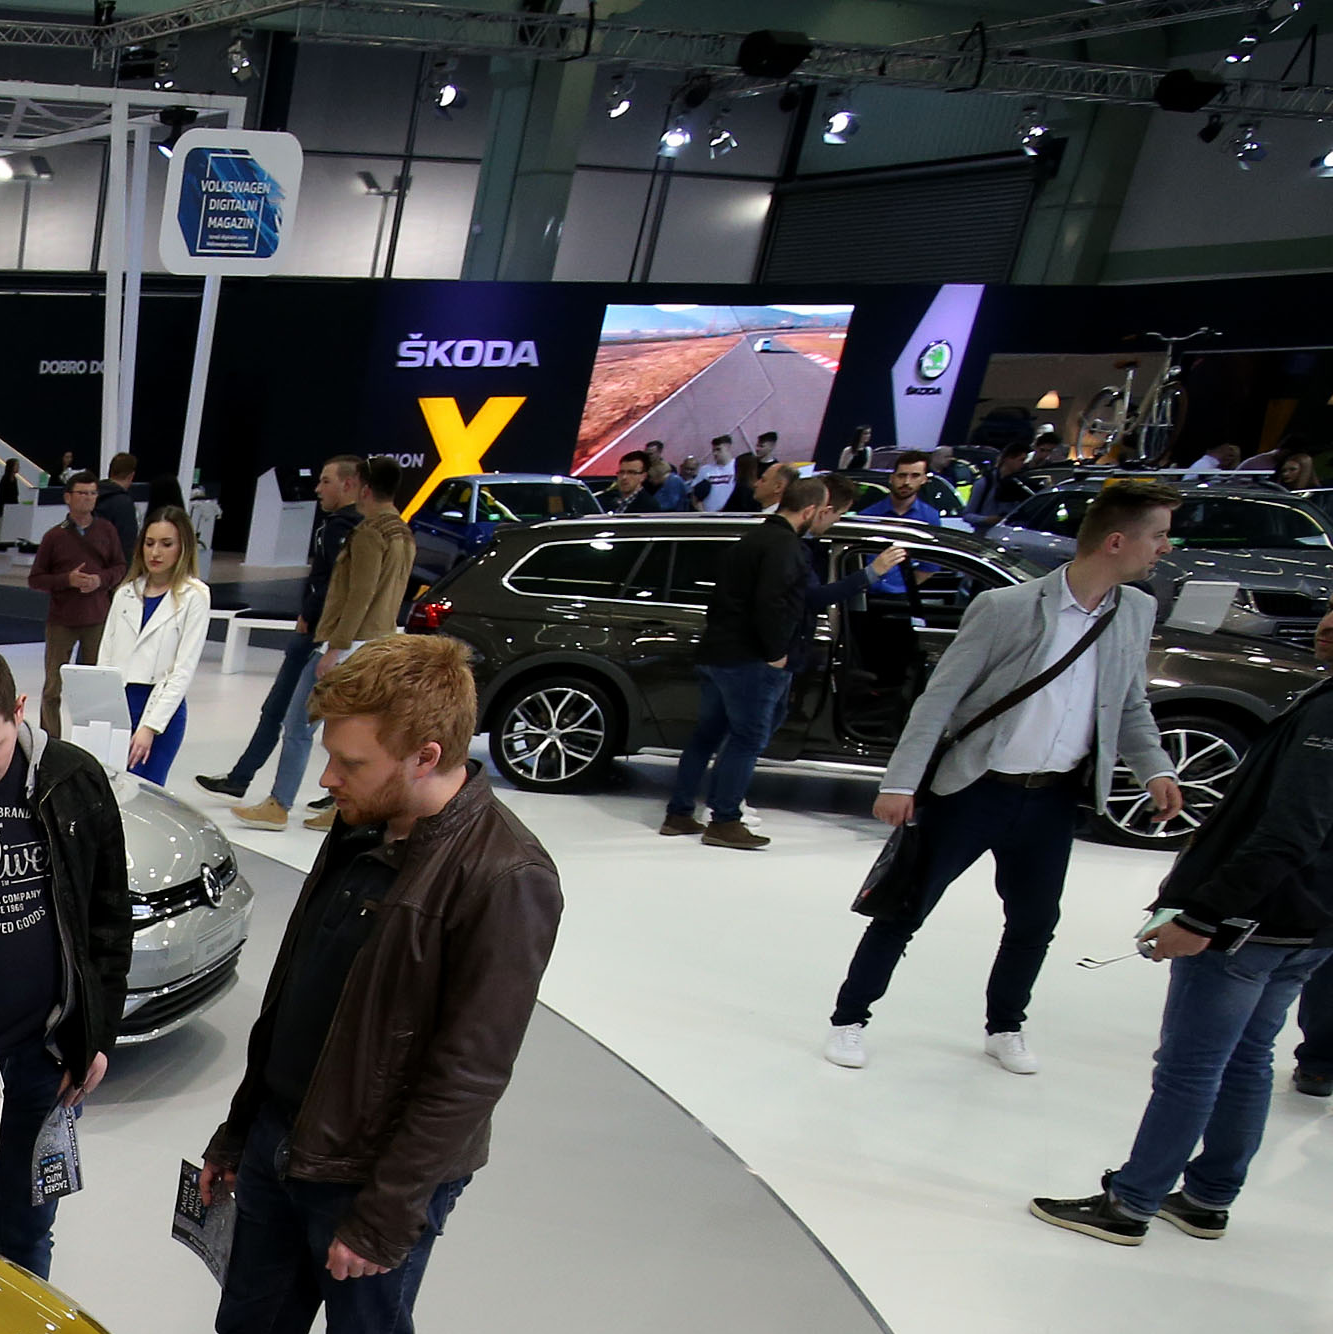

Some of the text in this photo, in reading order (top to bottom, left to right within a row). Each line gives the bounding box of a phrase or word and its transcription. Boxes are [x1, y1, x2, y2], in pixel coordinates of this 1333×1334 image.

[201, 180, 271, 194] VOLKSWAGEN
[208, 198, 259, 212] DIGITALNI
[207, 217, 255, 230] MAGAZIN
[395, 333, 540, 368] ŠKODA
[39, 360, 88, 374] DOBRO
[2, 888, 42, 905] COMPANY
[16, 906, 46, 930] GOODS
[43, 1161, 63, 1175] SHOW
[45, 1171, 63, 1184] AUTO
[44, 1180, 69, 1195] ZAGREB
